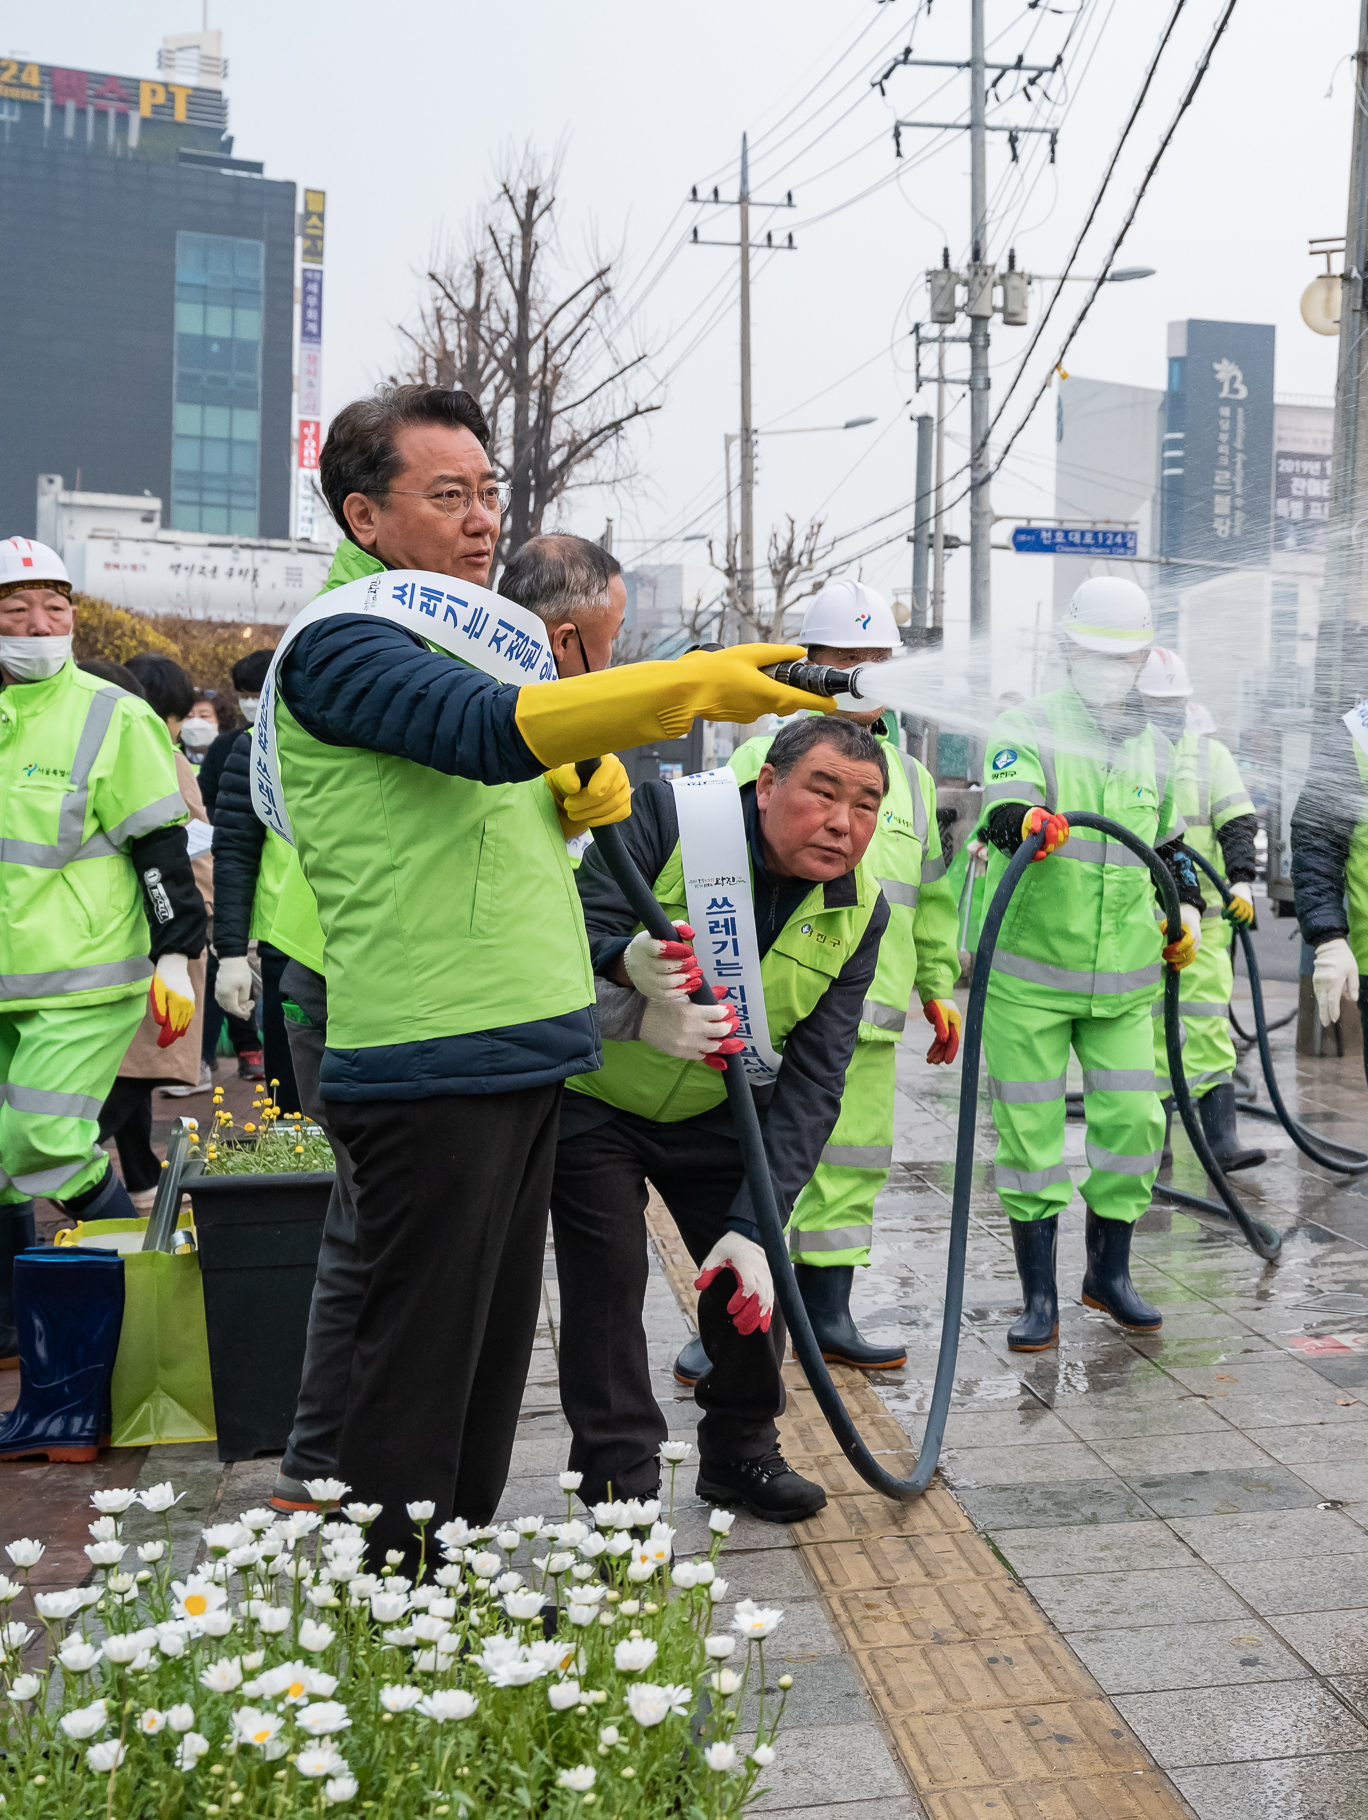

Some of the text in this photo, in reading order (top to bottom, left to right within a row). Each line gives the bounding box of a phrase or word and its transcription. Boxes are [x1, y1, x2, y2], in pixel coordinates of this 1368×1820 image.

[139, 80, 193, 123] PT
[392, 582, 490, 640] 쓰레기는
[487, 618, 544, 673] 지정된
[705, 896, 743, 978] 쓰레기는
